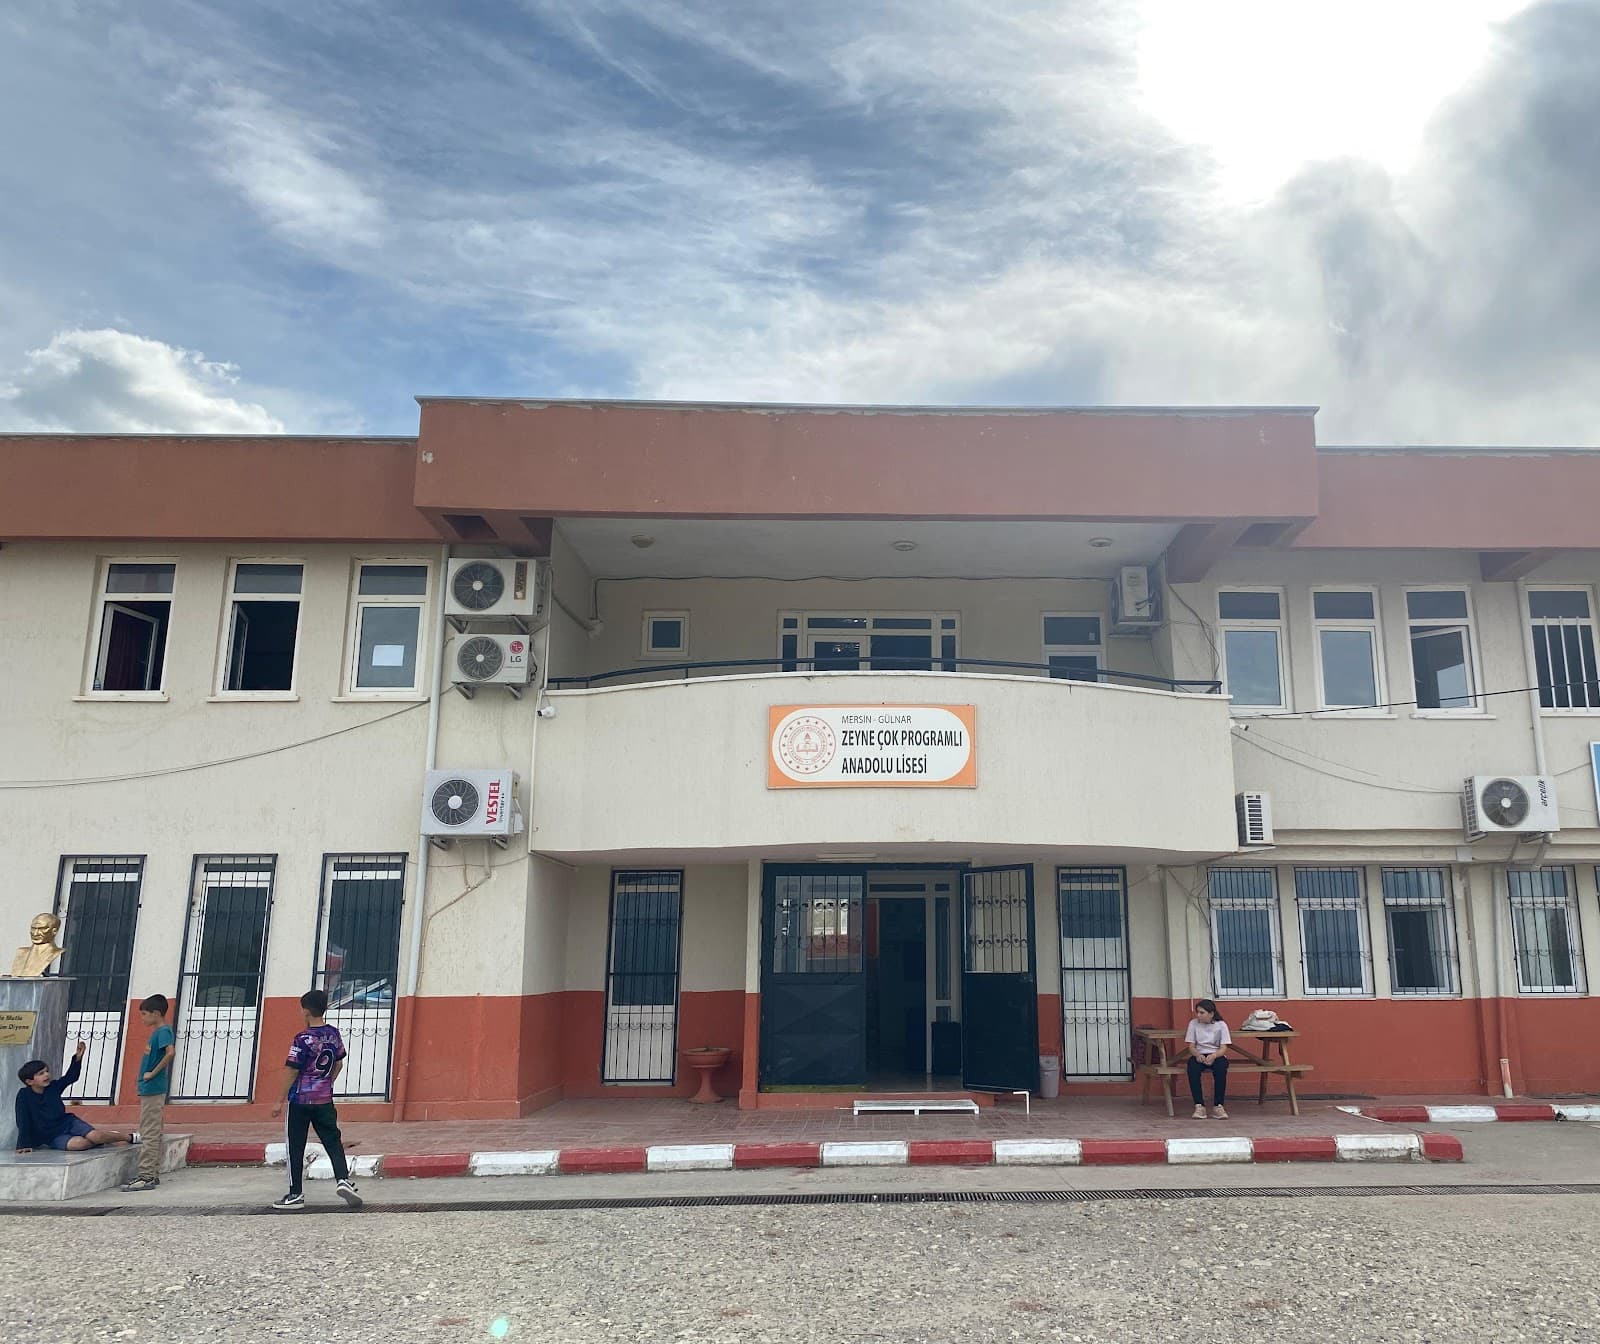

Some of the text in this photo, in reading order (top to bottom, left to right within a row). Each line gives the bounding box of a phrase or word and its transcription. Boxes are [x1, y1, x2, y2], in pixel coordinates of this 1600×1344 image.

[510, 655, 522, 663] LG
[878, 713, 912, 724] GÜLNAR
[841, 730, 874, 746] ZEYNE
[877, 730, 898, 750] ÇOK
[901, 730, 963, 747] PROGRAMLI
[841, 754, 927, 774] ANADOLU LİSESİ
[486, 780, 501, 825] VESTEL
[314, 1049, 334, 1080] 9
